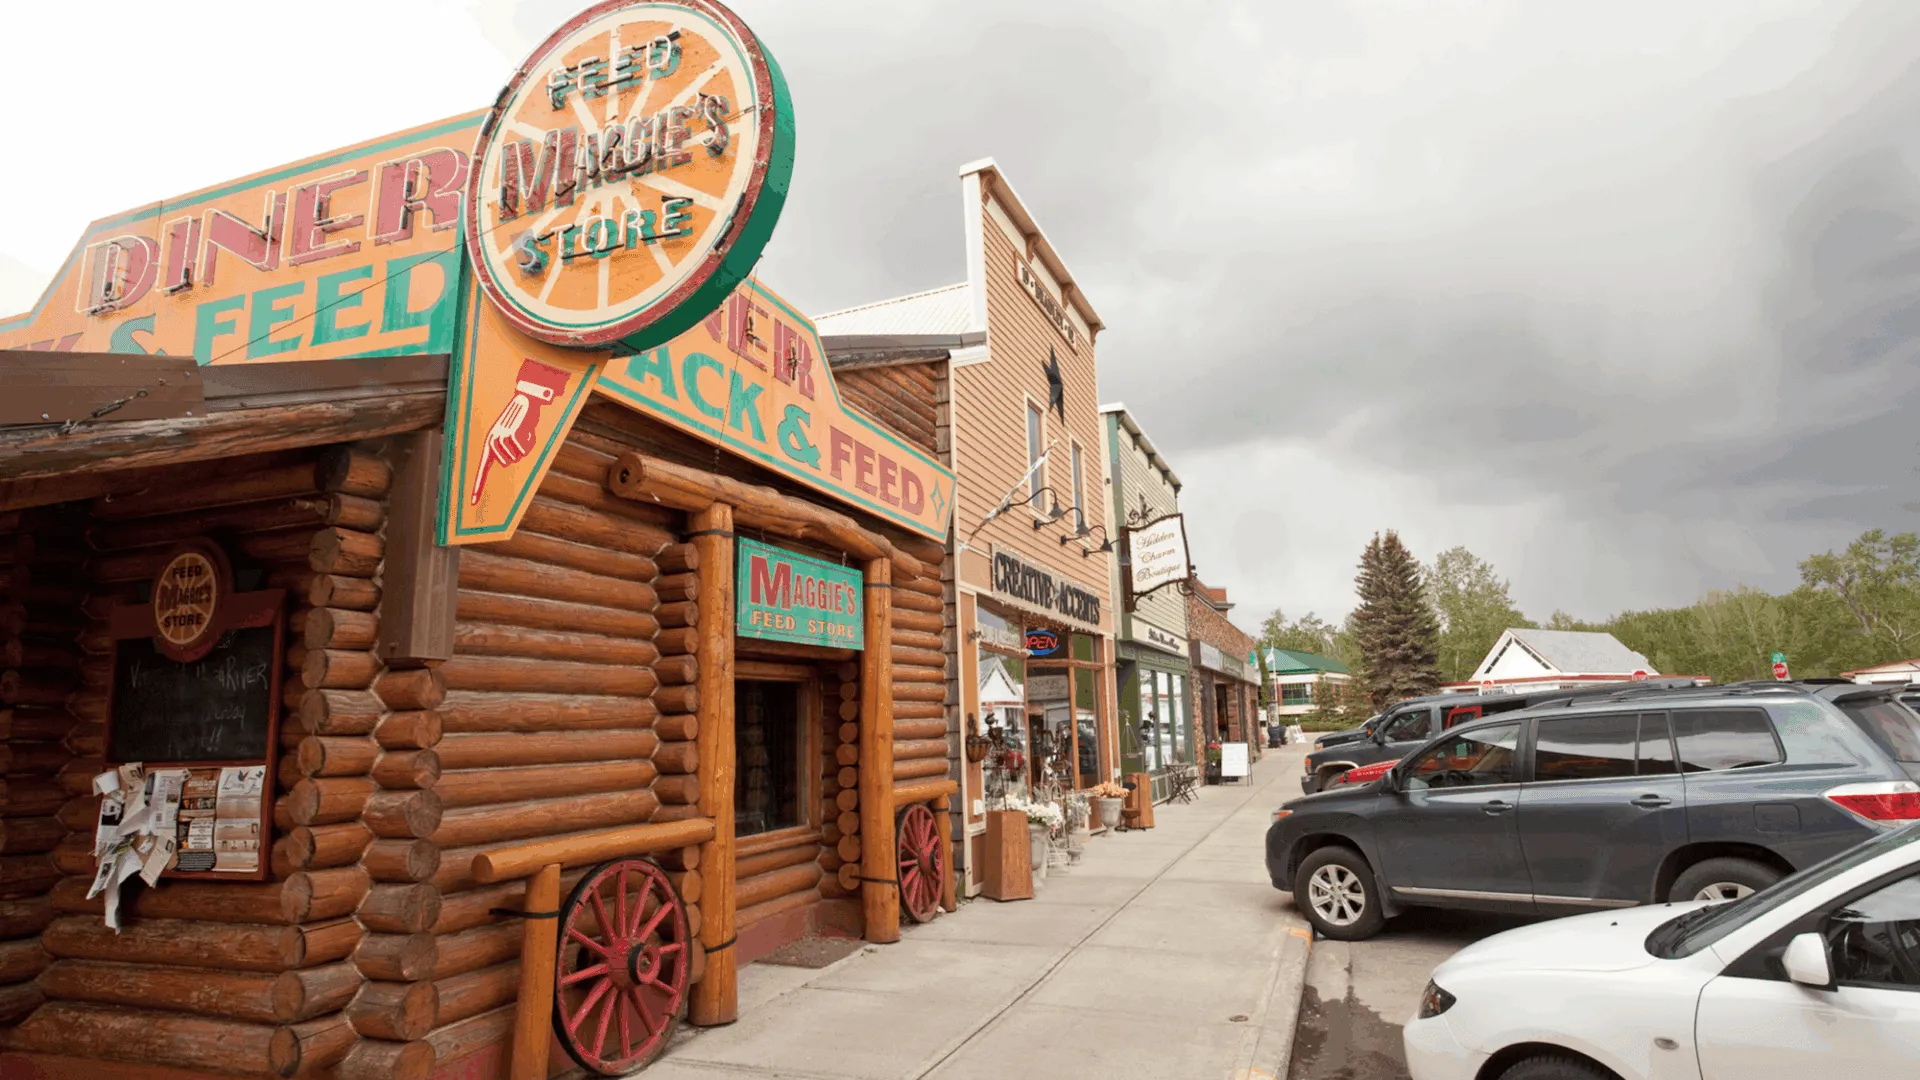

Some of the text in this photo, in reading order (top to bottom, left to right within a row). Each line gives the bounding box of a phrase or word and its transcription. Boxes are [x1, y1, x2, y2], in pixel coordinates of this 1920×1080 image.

[546, 33, 683, 110] FEED
[498, 92, 731, 224] MAGGIE'S
[75, 146, 470, 316] DINER
[518, 195, 694, 275] STORE
[193, 250, 463, 366] FEED
[624, 345, 925, 516] ACK & FEED
[172, 565, 203, 579] FEED
[750, 554, 856, 616] MAGGIE'S
[994, 551, 1100, 625] CREATIVE ACCENTS
[164, 613, 203, 628] STORE
[751, 609, 855, 639] FEED STORE
